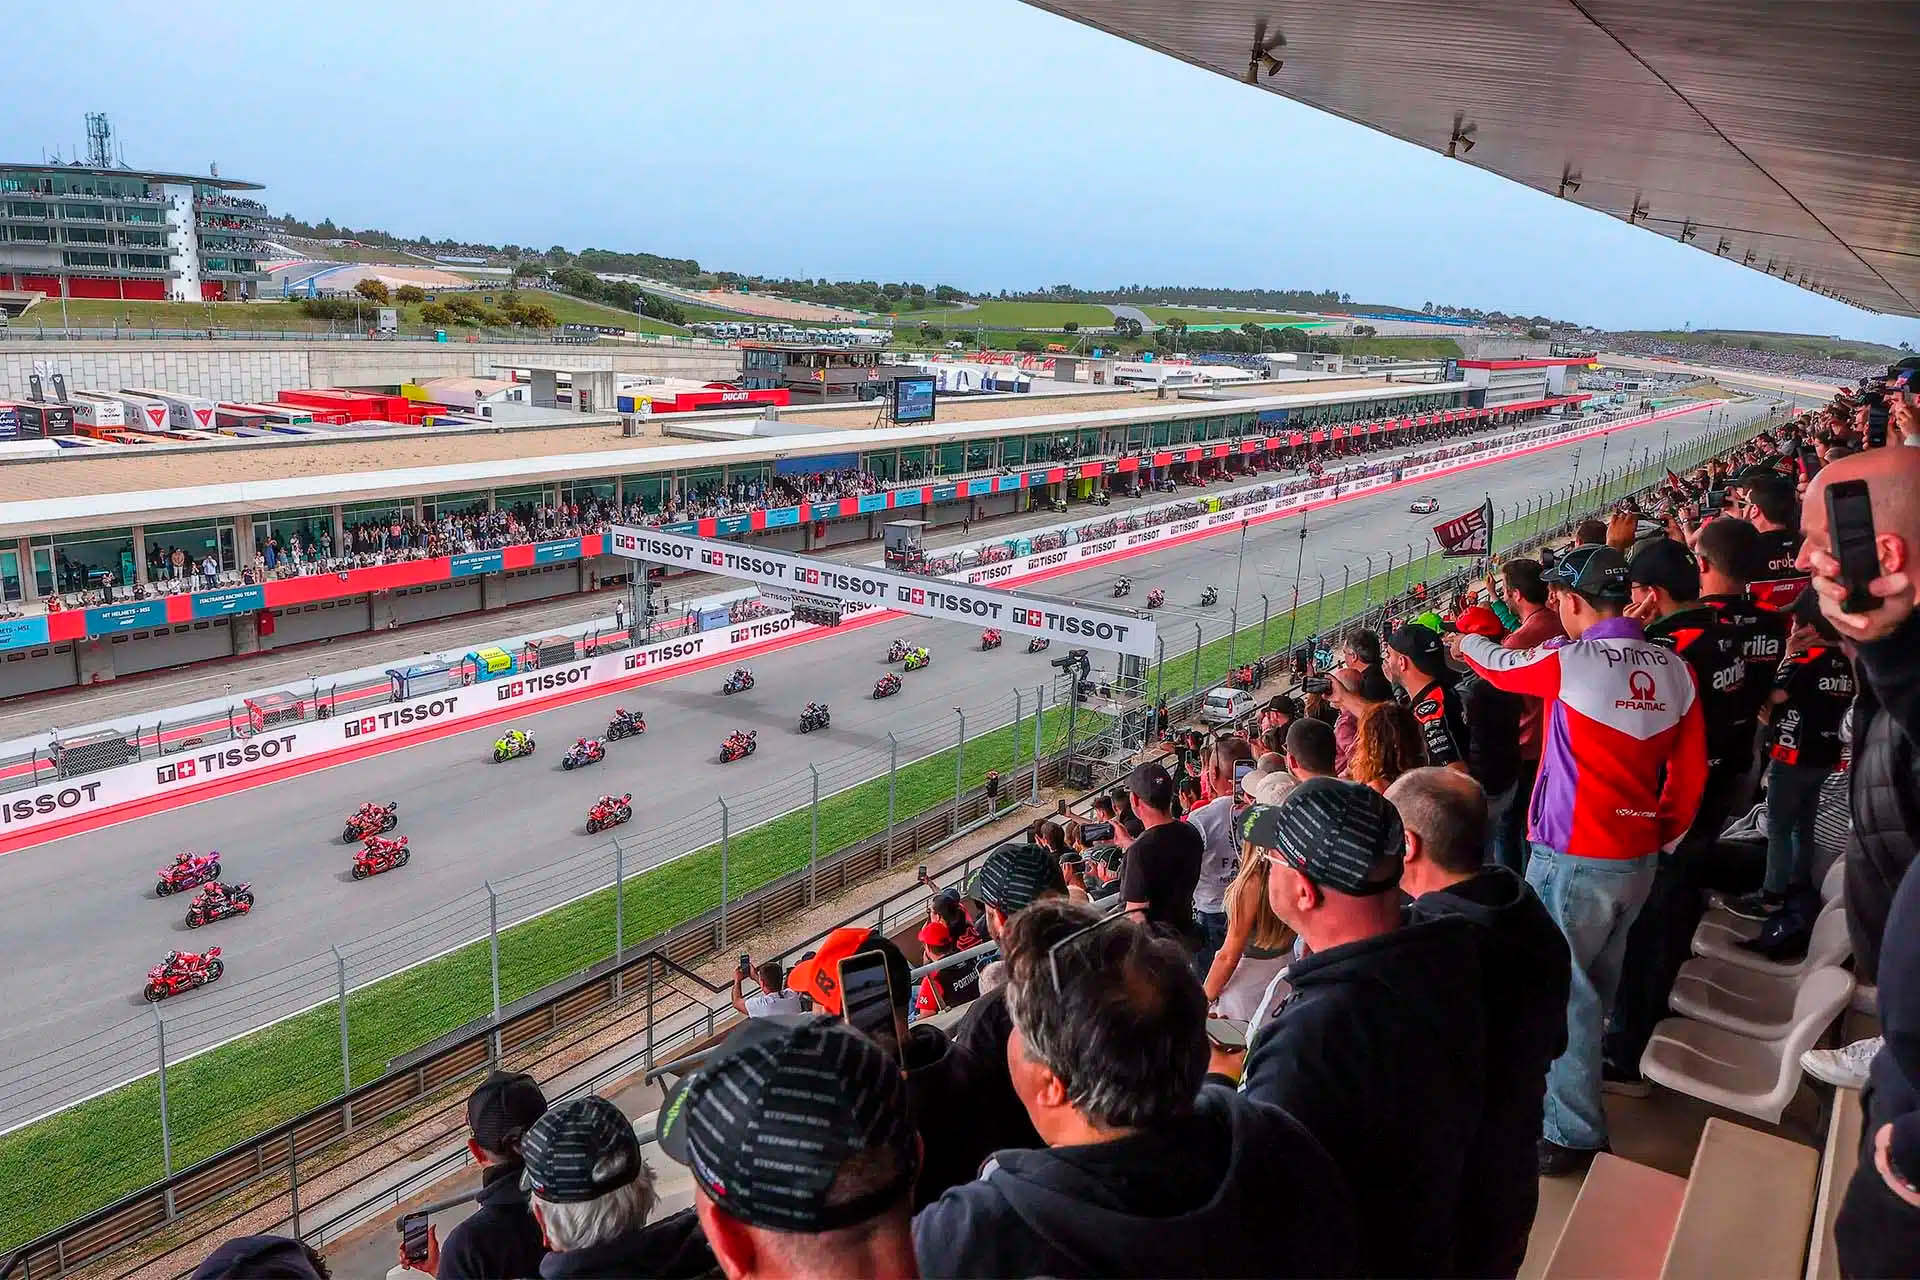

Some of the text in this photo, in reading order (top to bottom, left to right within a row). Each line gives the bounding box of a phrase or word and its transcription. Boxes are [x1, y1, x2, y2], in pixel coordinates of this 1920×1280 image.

[721, 391, 749, 402] DUCATI
[1179, 519, 1199, 532] TISSOT
[1216, 511, 1235, 524] TISSOT
[1137, 529, 1160, 543] TISSOT
[637, 537, 694, 561] TISSOT
[1092, 540, 1117, 554] TISSOT
[725, 554, 787, 578] TISSOT
[1039, 551, 1068, 567] TISSOT
[1768, 551, 1795, 570] arub
[981, 565, 1013, 581] TISSOT
[225, 592, 244, 600] RACING
[820, 573, 888, 598] TISSOT
[111, 608, 136, 617] HELMETS
[926, 591, 1003, 620] TISSOT
[750, 617, 797, 638] TISSOT
[1045, 613, 1129, 643] TISSOT
[648, 639, 703, 664] TISSOT
[1743, 634, 1779, 656] rilia
[1599, 647, 1668, 668] prima
[525, 665, 592, 694] TISSOT
[378, 697, 458, 730] TISSOT
[1615, 700, 1666, 712] PRAMAC
[1776, 708, 1800, 749] prilia
[199, 734, 297, 773] TISSOT
[2, 781, 101, 824] ISSOT
[919, 996, 929, 1005] 24
